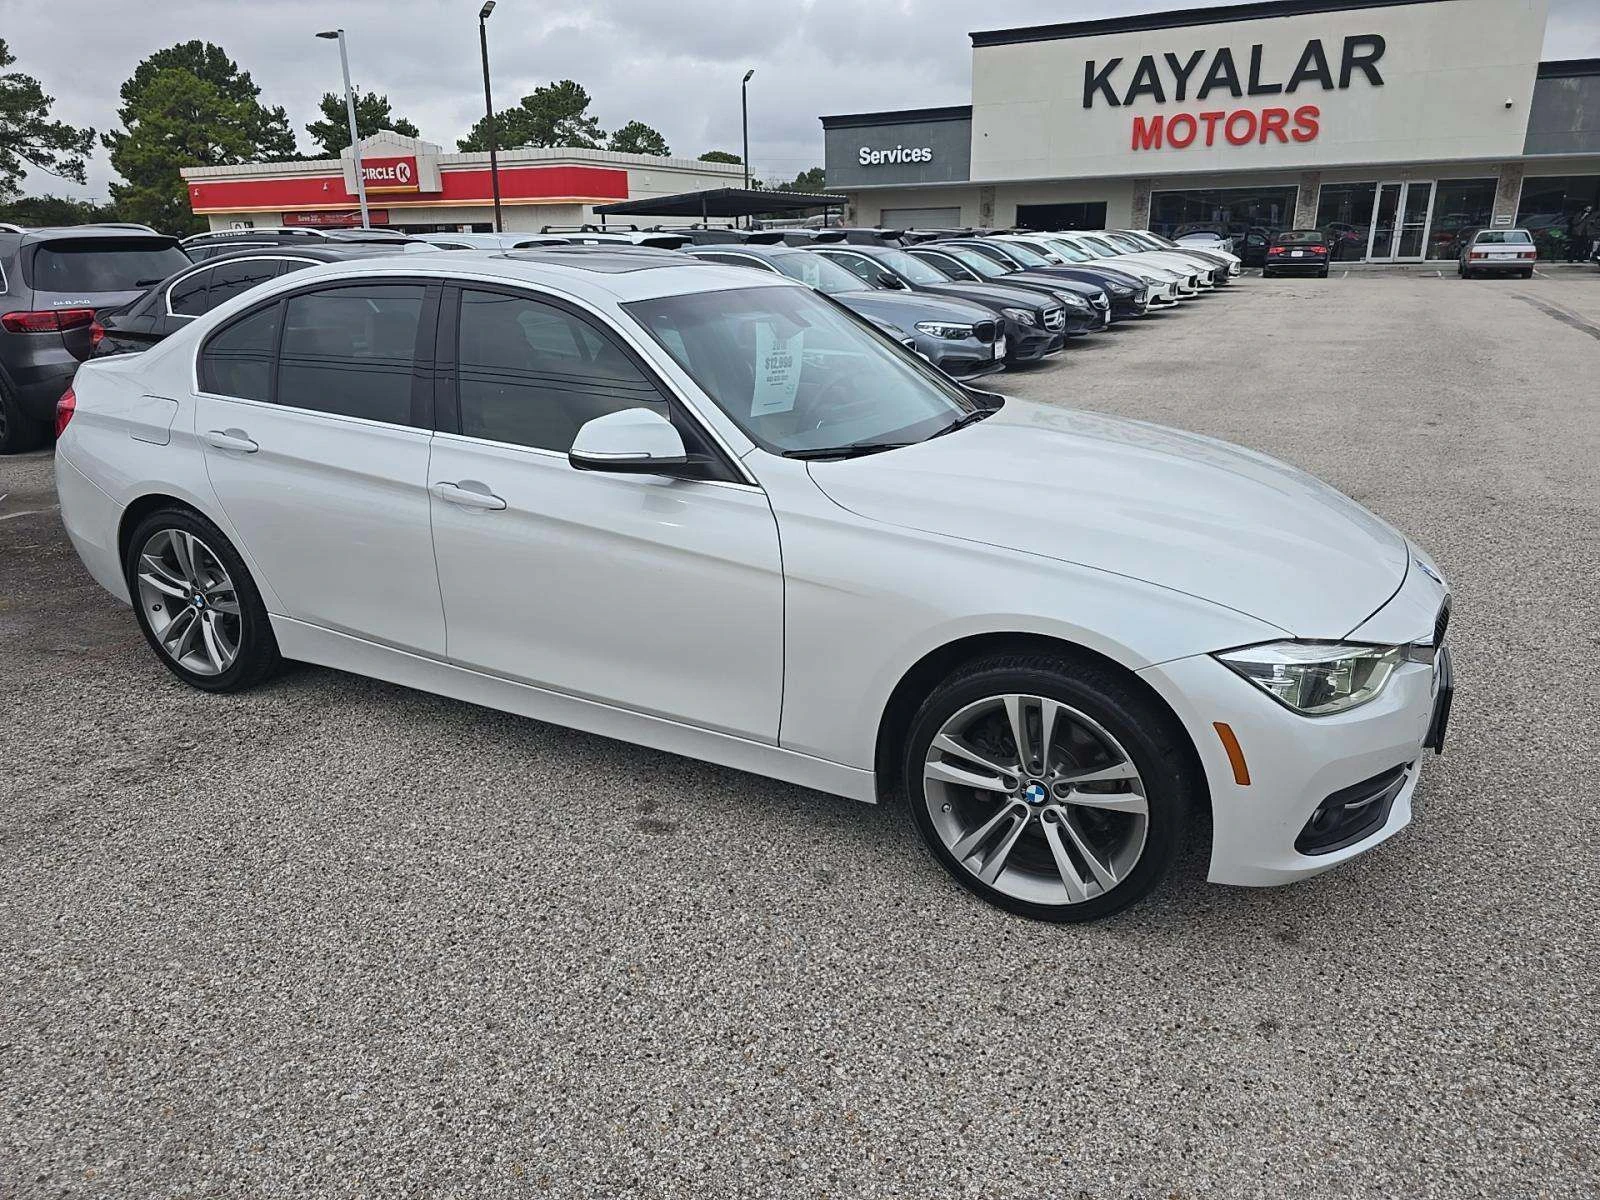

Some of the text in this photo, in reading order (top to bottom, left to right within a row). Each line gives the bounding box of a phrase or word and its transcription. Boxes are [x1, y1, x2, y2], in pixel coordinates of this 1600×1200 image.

[1083, 33, 1386, 109] KAYALAR
[1131, 105, 1321, 150] MOTORS
[859, 145, 932, 165] Services
[361, 164, 410, 182] CIRCLE K
